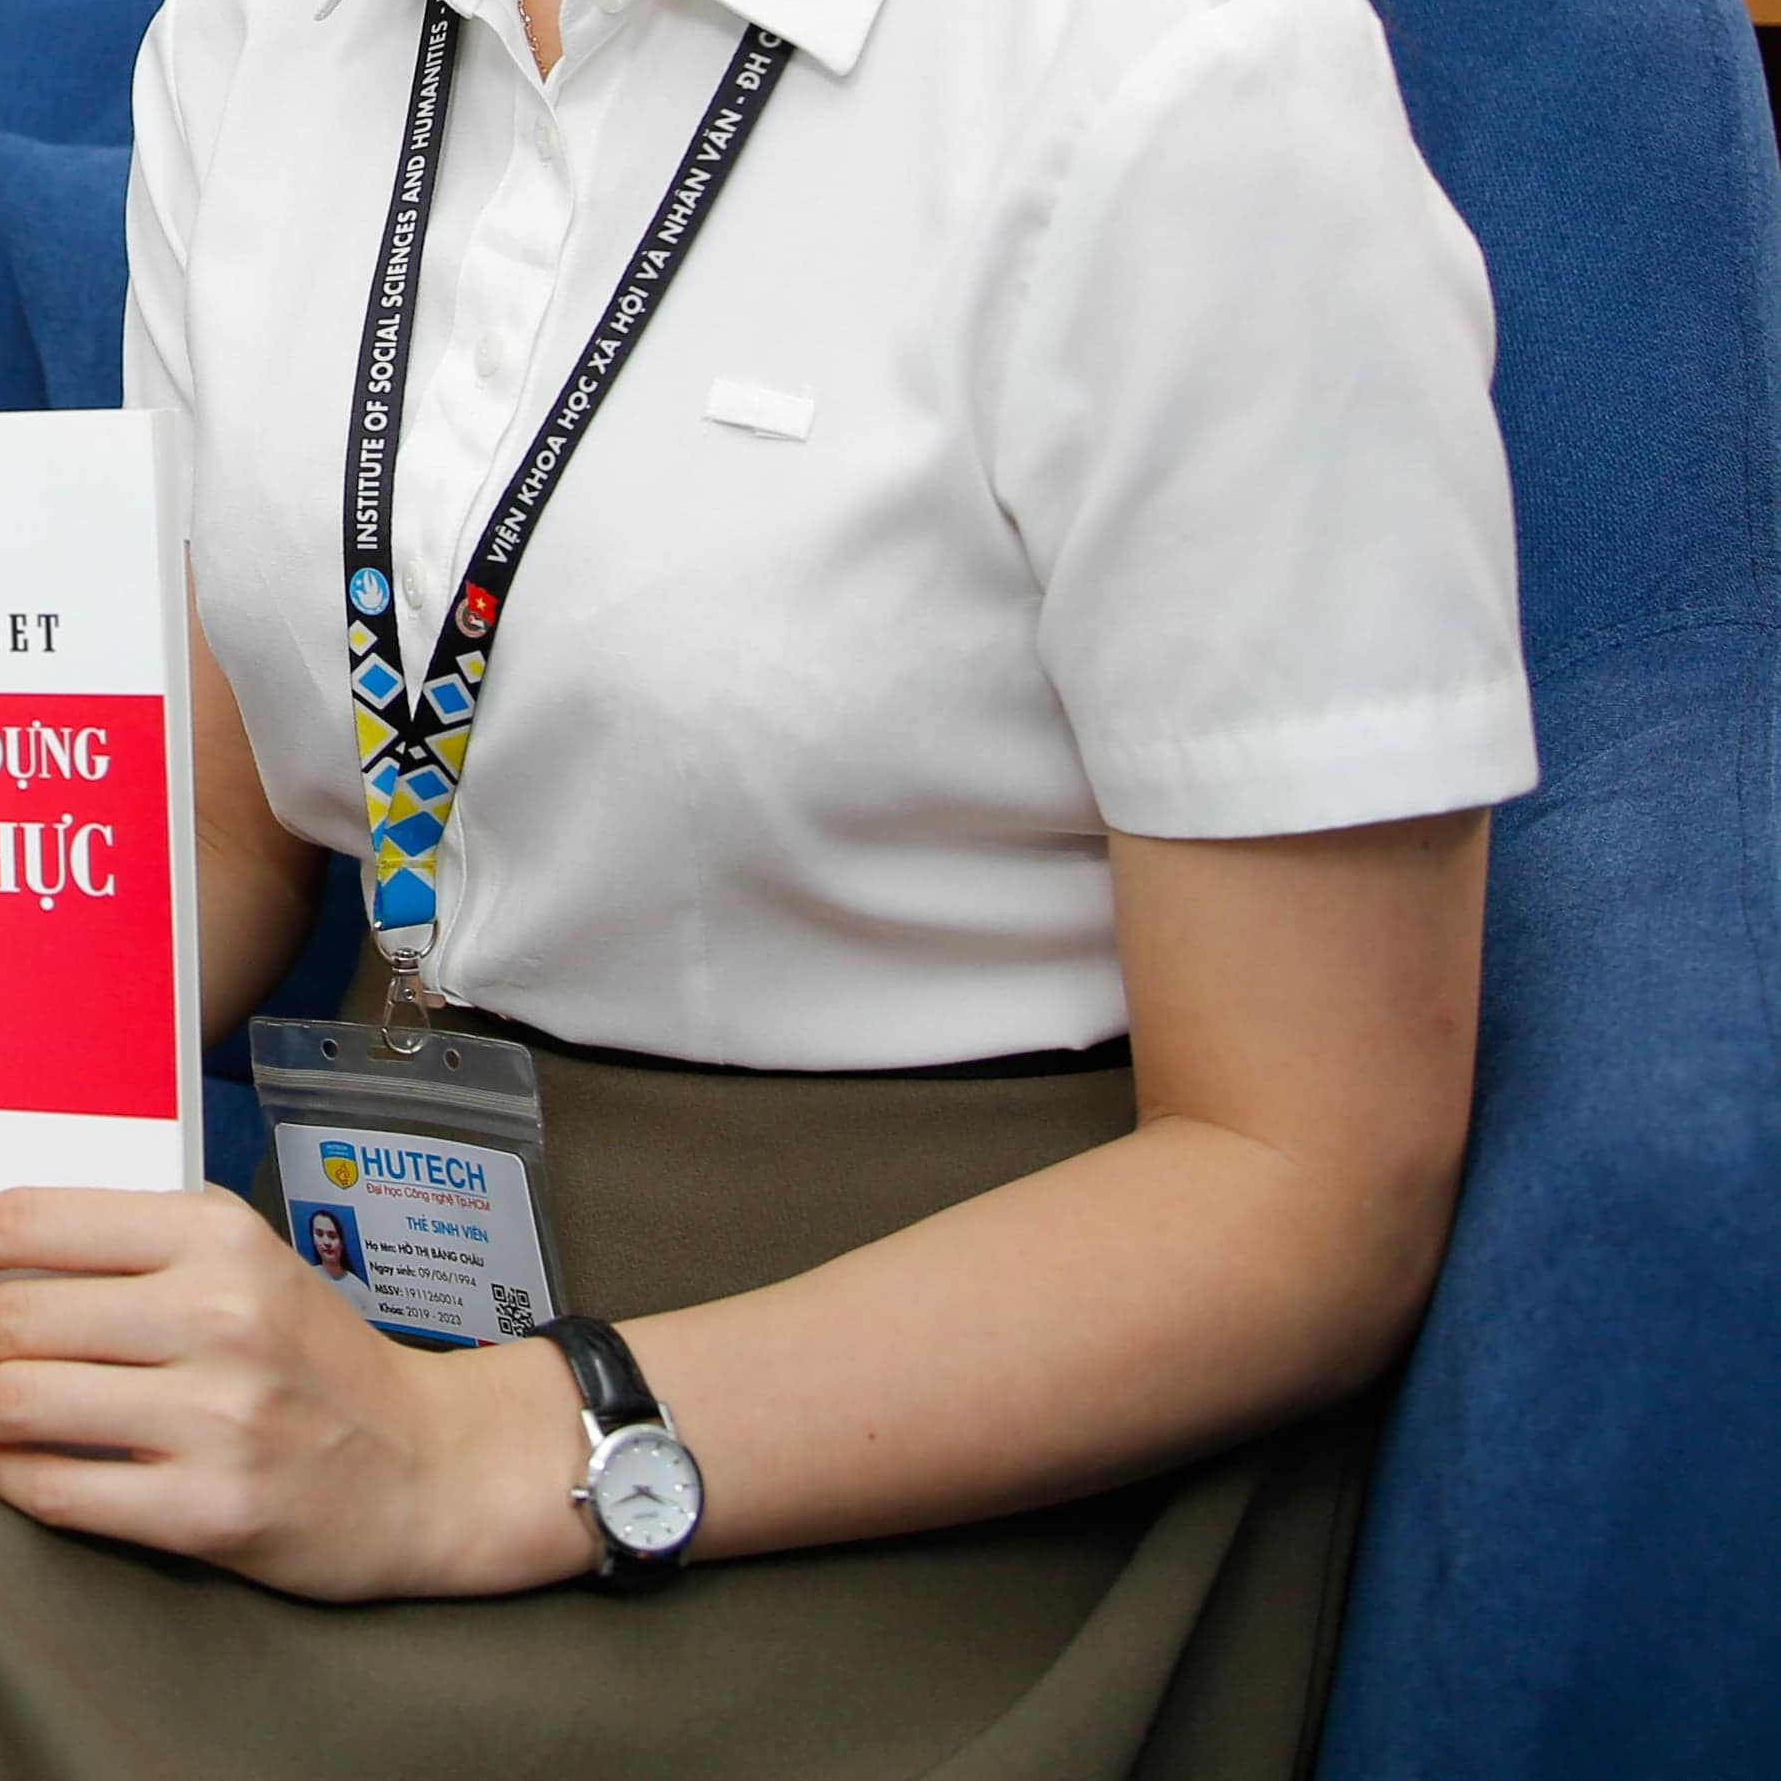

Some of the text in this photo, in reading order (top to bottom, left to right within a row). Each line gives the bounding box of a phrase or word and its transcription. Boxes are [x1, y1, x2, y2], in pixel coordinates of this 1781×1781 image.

[411, 19, 448, 151] HUMANITIES
[402, 155, 426, 203] AND
[381, 208, 418, 308] SCIENCES
[487, 507, 528, 563] VIỆN
[517, 434, 567, 507] KHOA
[557, 375, 598, 431] HỌC
[588, 336, 622, 374] XÃ
[609, 285, 649, 334] HỘI
[635, 248, 671, 282] VÀ
[657, 167, 712, 245] NHÂN
[696, 108, 743, 161] VĂN
[735, 52, 772, 91] ĐH
[369, 313, 401, 393] SOCIAL
[364, 400, 390, 432] OF
[357, 438, 385, 550] INSTITUTE
[359, 1145, 488, 1195] HUTECH
[366, 1182, 383, 1195] Đại
[384, 1185, 402, 1198] học
[404, 1186, 430, 1203] Công
[431, 1192, 454, 1206] nghệ
[405, 1213, 489, 1244] THẺ SINH VIÊN
[405, 1306, 430, 1319] 2019
